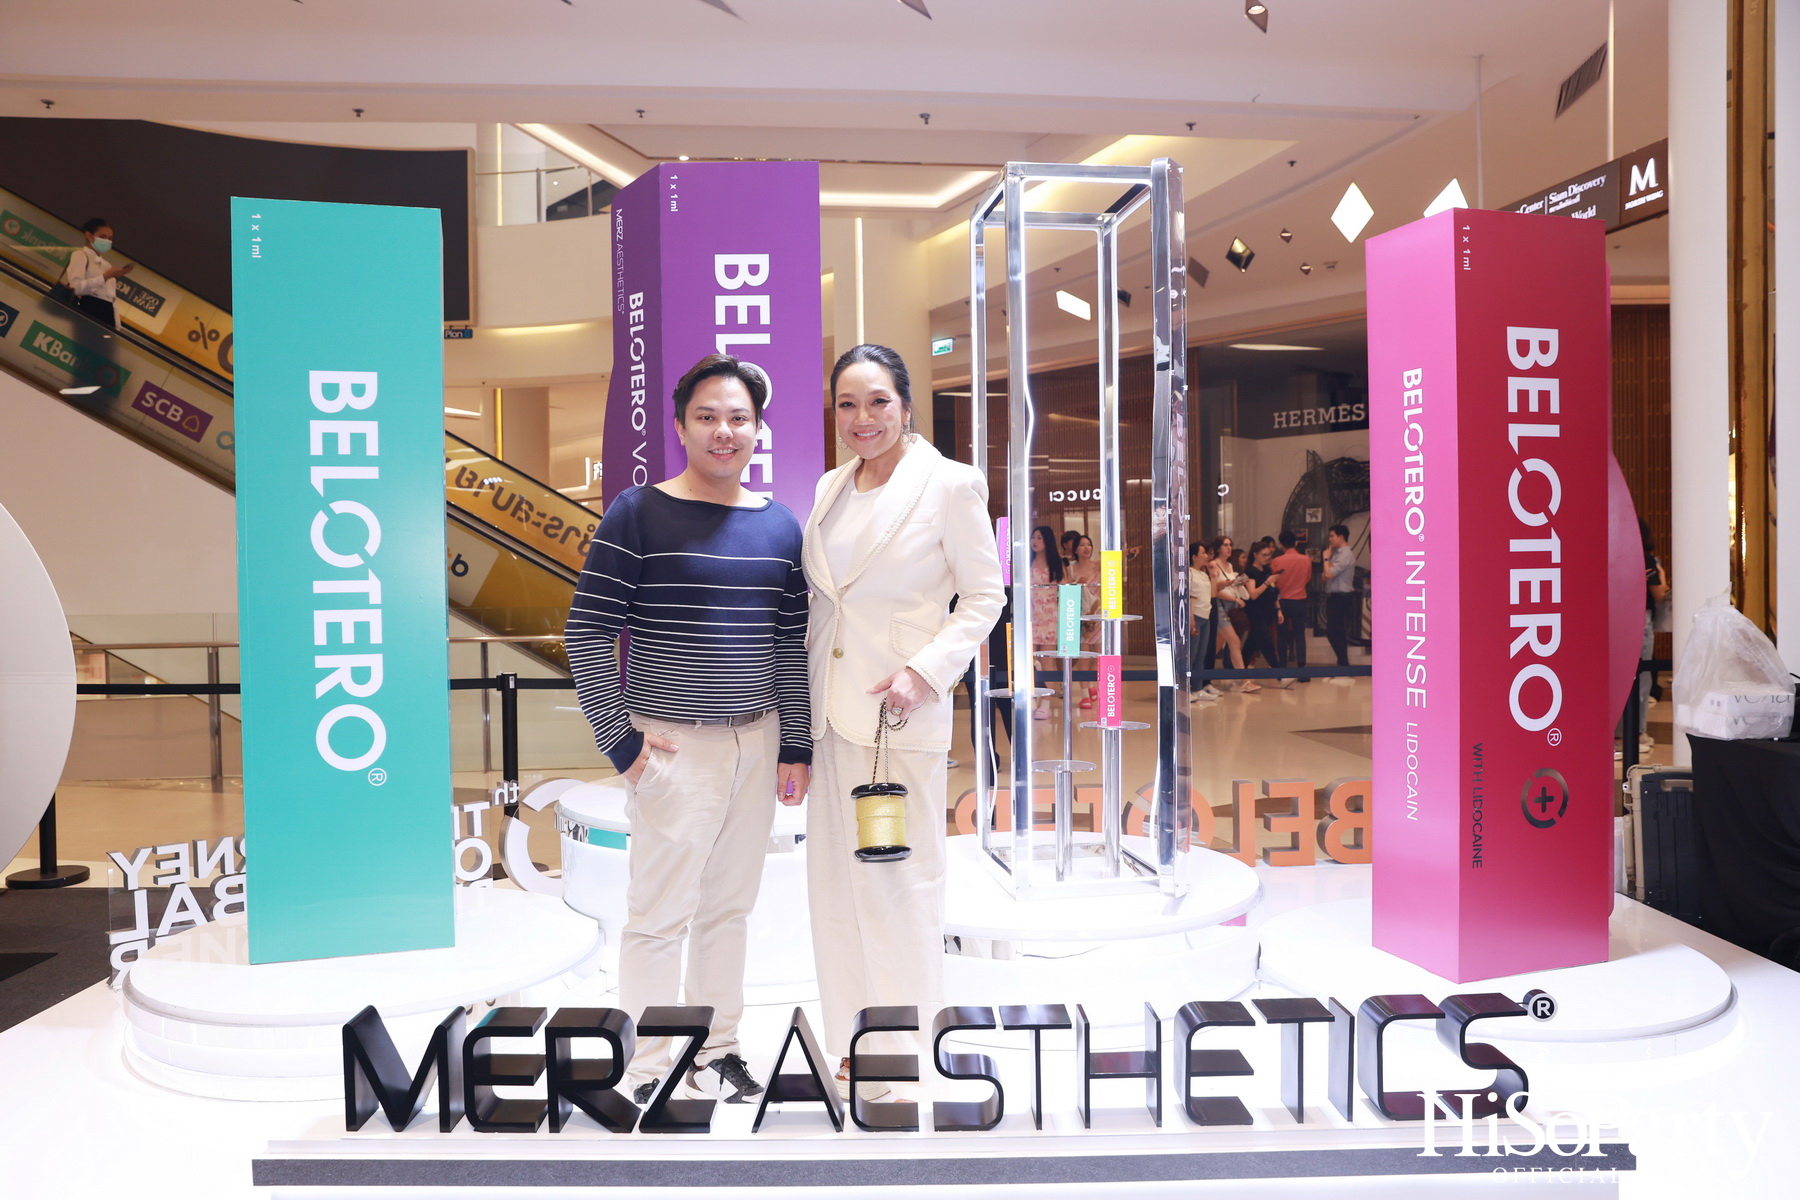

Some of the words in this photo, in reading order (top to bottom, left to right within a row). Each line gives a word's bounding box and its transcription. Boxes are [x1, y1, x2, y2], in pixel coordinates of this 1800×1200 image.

[1548, 191, 1568, 205] Siam
[1567, 174, 1607, 197] Discovery
[1628, 157, 1659, 196] M
[1571, 205, 1597, 219] World
[141, 390, 184, 423] SCB
[1404, 550, 1427, 709] INTENSE
[1405, 721, 1418, 822] LIDOCAIN
[1471, 742, 1484, 783] WITH
[1471, 787, 1484, 870] LIDOCAINE
[342, 1004, 718, 1134] MERZ
